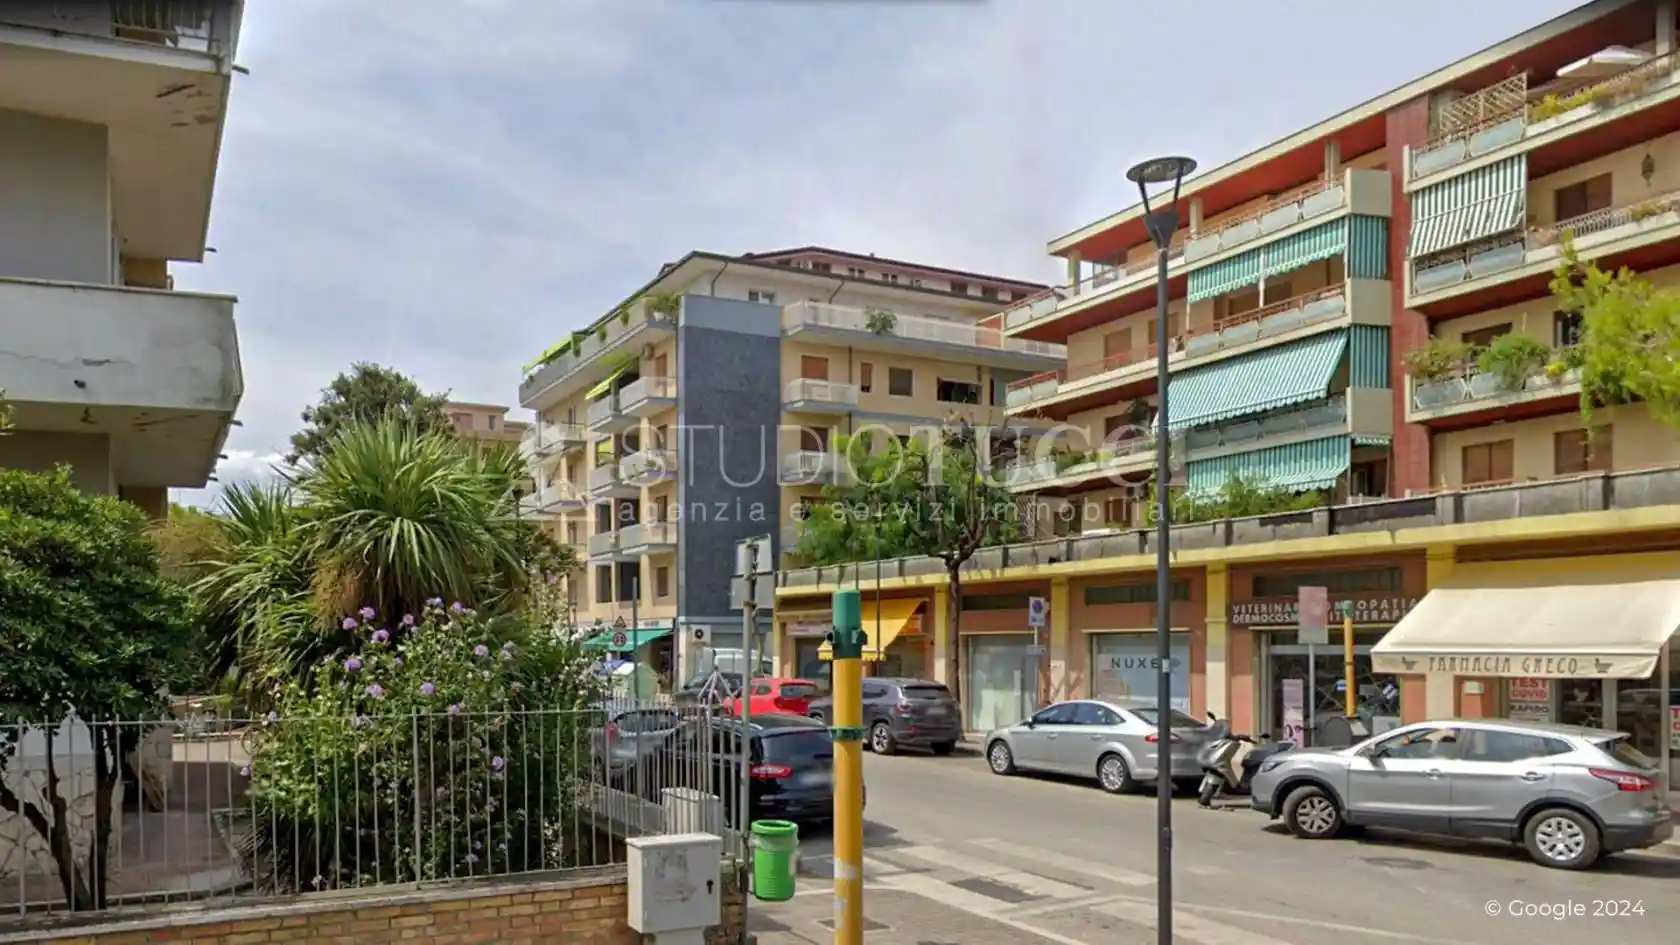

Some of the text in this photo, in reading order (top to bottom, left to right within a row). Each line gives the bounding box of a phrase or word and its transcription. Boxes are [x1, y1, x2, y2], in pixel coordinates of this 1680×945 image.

[1232, 603, 1300, 613] VETERINAR
[1428, 656, 1578, 675] FARMACIA GRECO
[1511, 676, 1548, 688] TEST
[1512, 689, 1547, 699] COVID
[1510, 704, 1549, 713] RAPIDO
